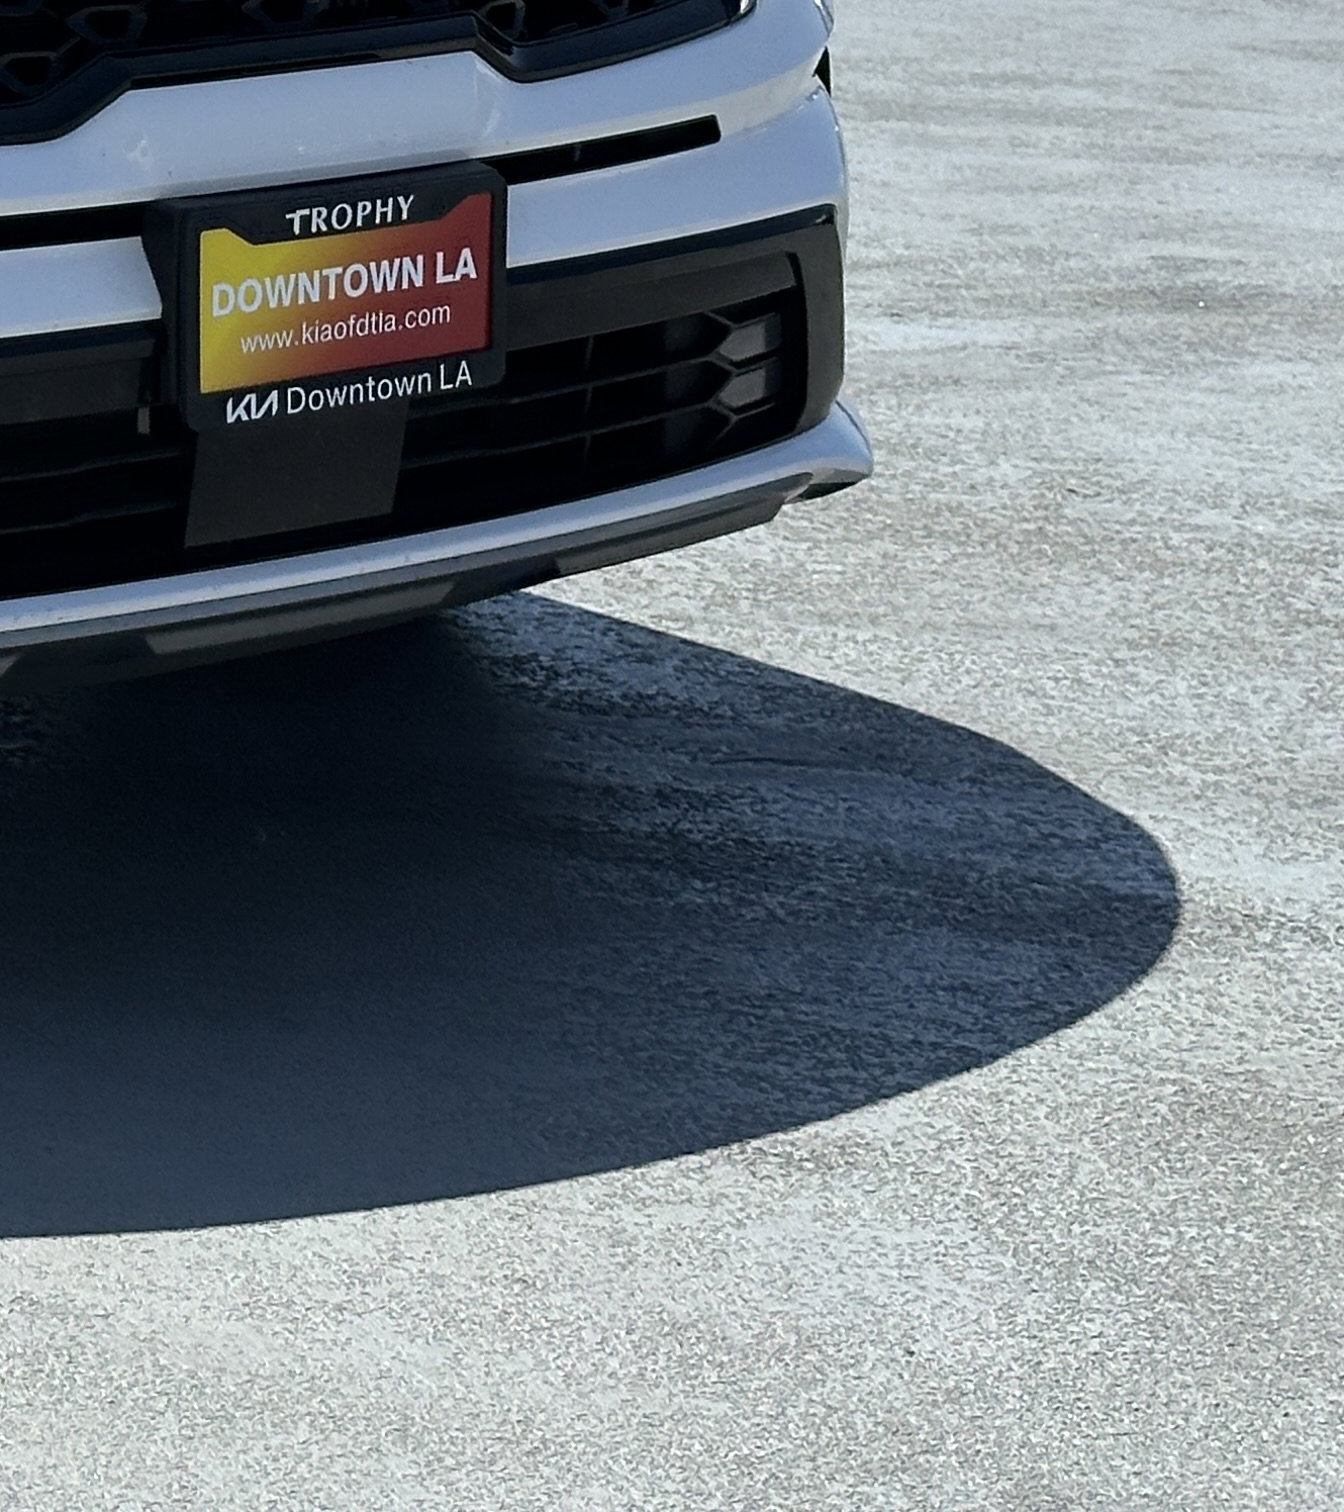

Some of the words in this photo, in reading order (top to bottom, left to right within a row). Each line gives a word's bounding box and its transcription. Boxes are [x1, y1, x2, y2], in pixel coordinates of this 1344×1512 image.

[286, 194, 414, 236] TROPHY
[212, 253, 424, 317] DOWNTOWN
[435, 247, 478, 285] LA
[240, 304, 451, 355] www.kiaofdtla.com
[225, 389, 278, 424] KIA
[287, 372, 431, 415] Downtown
[440, 360, 473, 390] LA
